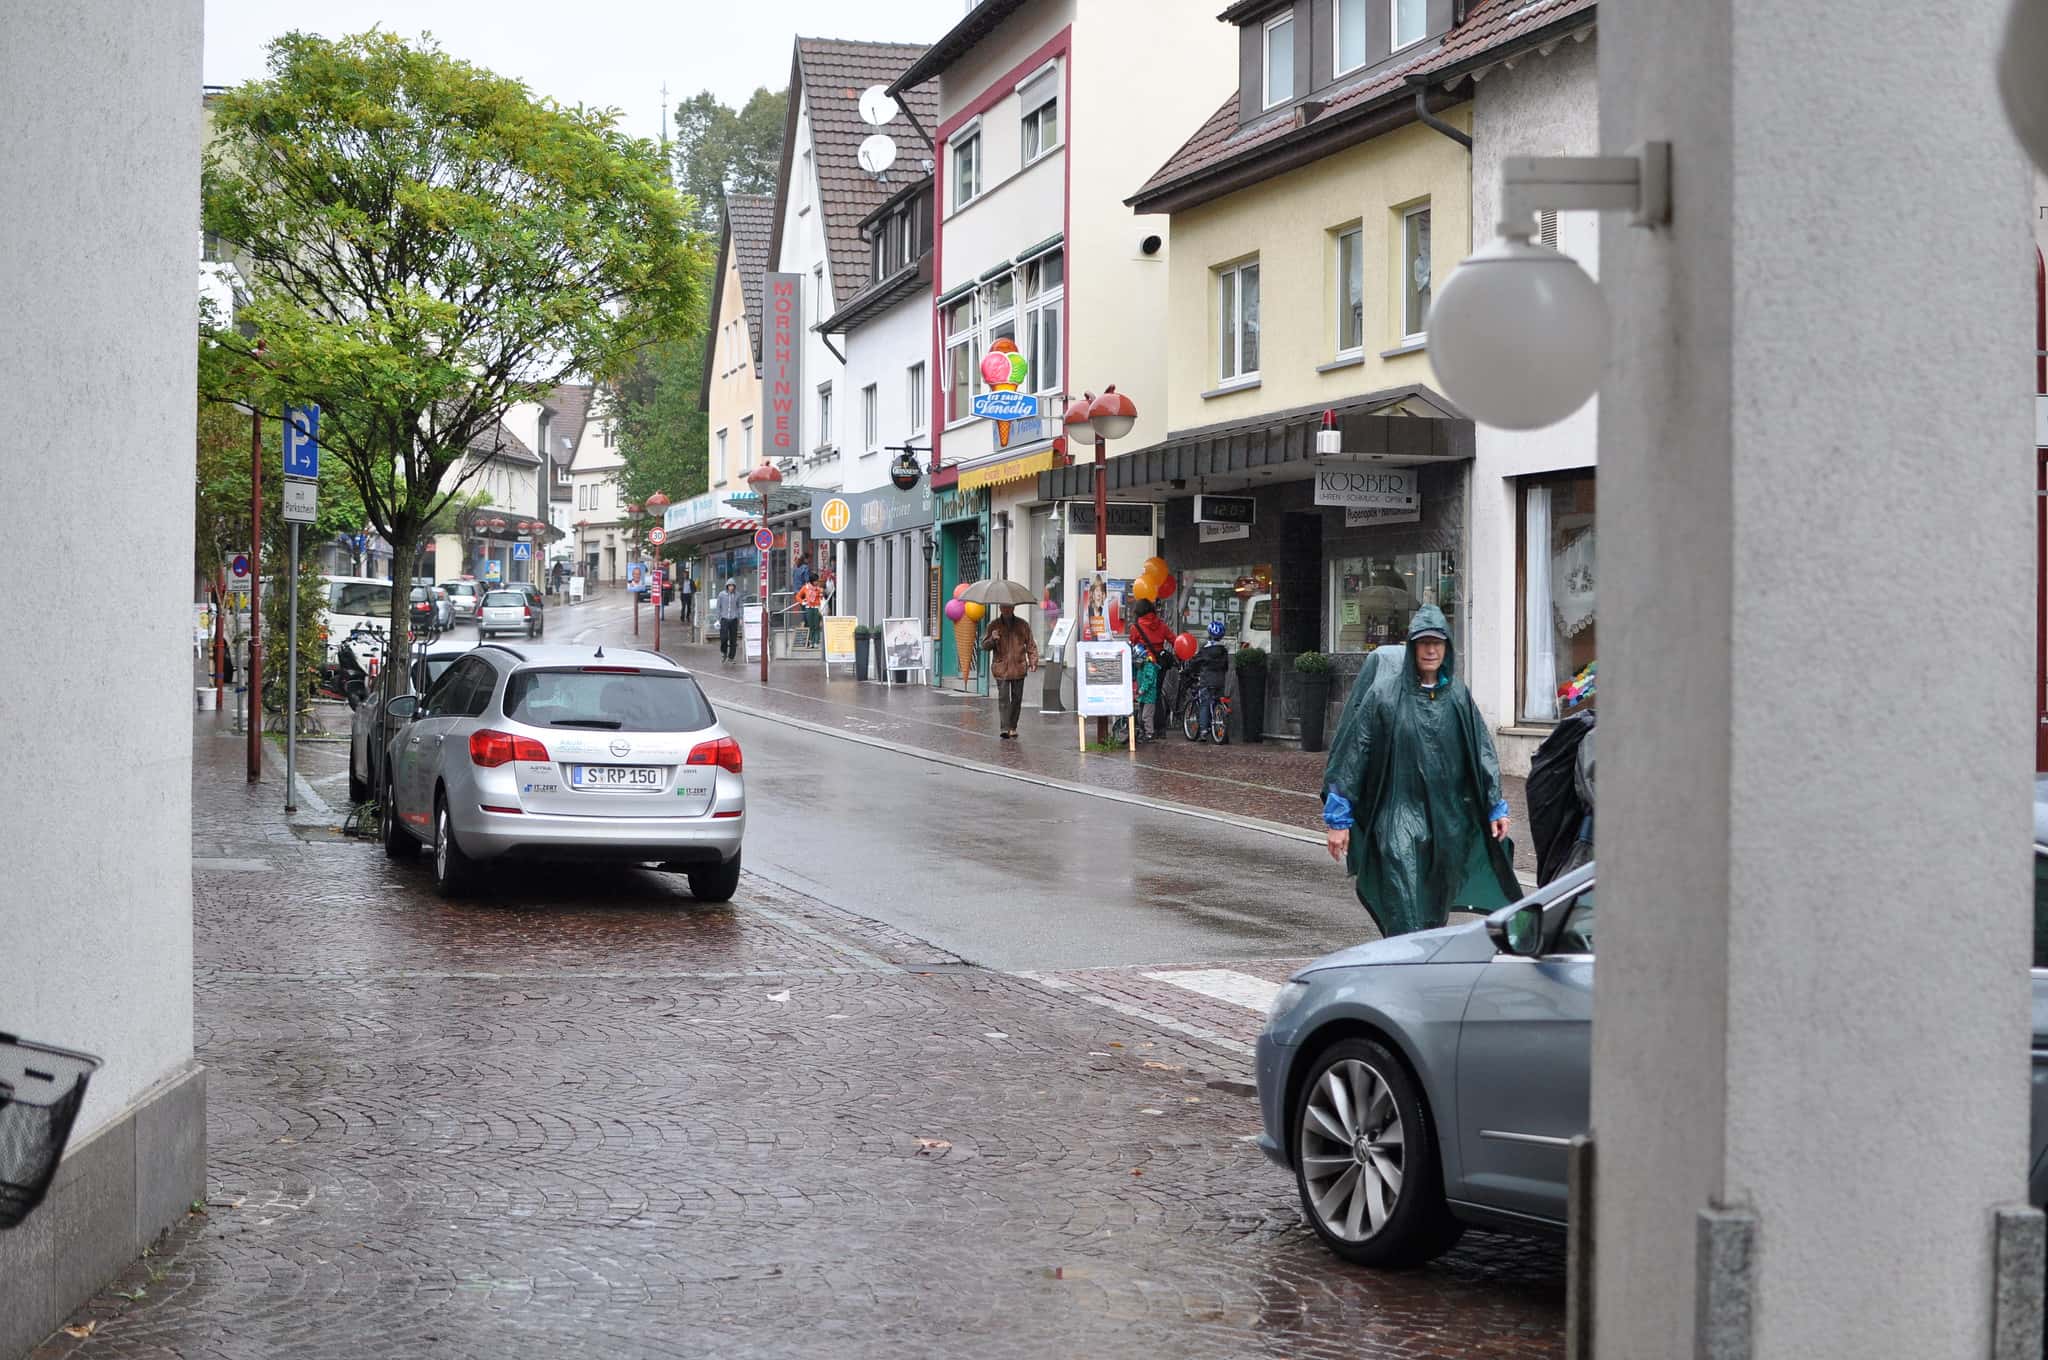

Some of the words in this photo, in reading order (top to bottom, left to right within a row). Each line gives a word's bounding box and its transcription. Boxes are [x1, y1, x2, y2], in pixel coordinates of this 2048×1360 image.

[773, 280, 794, 448] MORNHINWEG
[975, 399, 1033, 416] Venedig
[291, 410, 312, 467] P
[653, 531, 663, 540] 30
[588, 768, 597, 783] S
[607, 768, 626, 784] RP
[629, 768, 657, 784] 150
